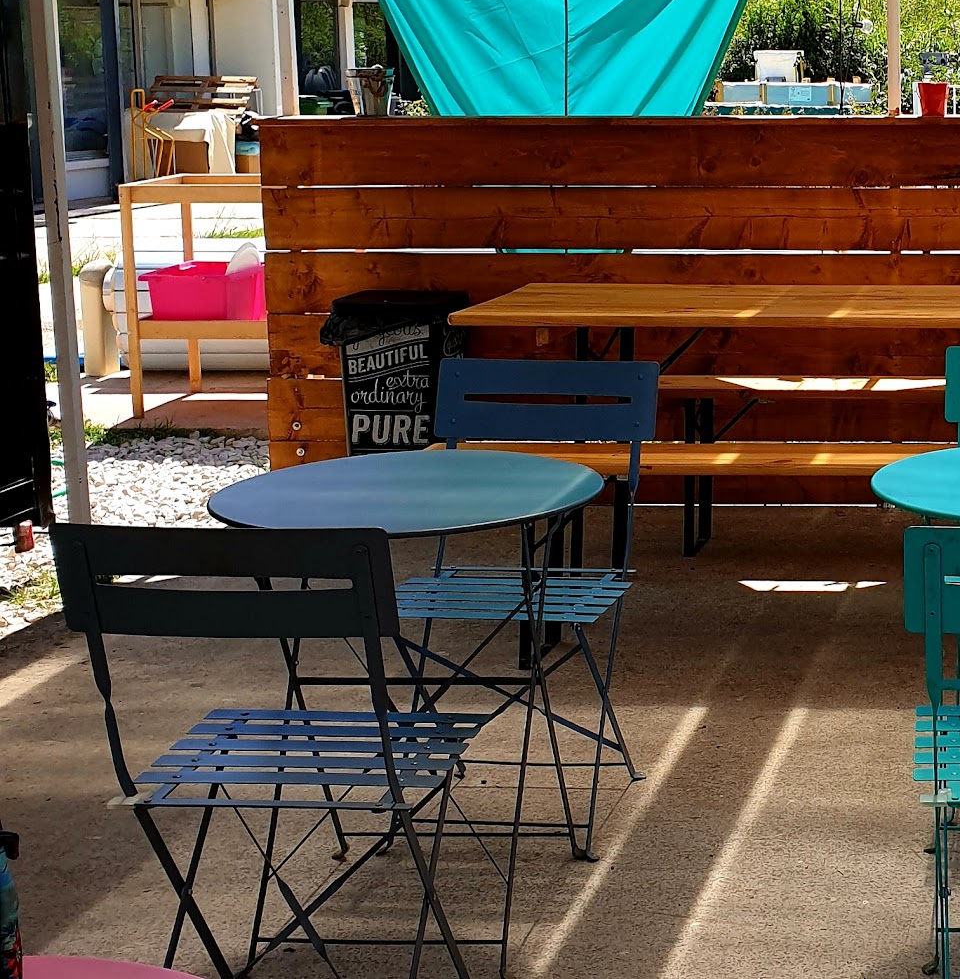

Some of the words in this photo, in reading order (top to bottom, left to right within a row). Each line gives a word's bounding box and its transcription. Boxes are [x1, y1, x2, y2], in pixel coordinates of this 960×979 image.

[348, 343, 429, 375] BEAUTIFUL
[350, 378, 427, 413] ordinary
[386, 370, 430, 390] extra
[352, 413, 431, 445] PURE
